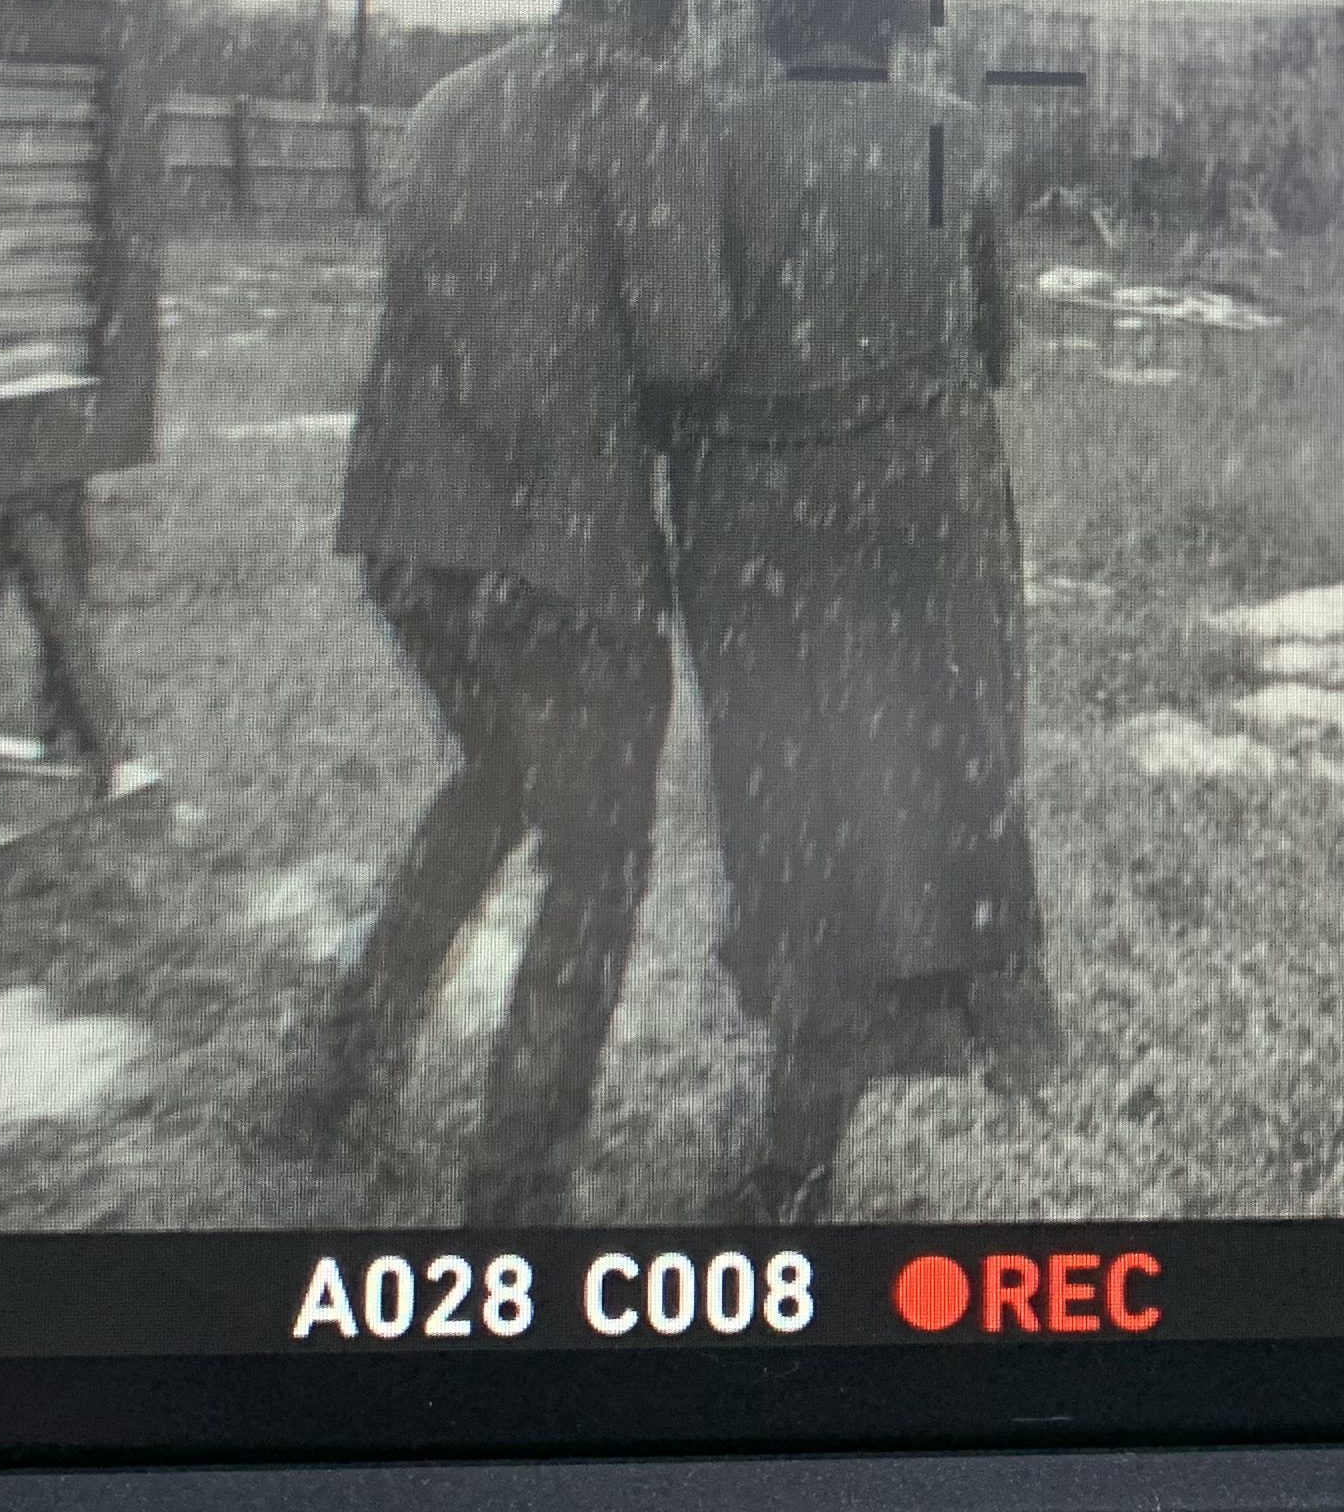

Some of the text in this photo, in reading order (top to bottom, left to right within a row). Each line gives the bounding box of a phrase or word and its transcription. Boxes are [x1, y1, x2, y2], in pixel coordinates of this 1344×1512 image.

[292, 1250, 814, 1338] A028 C008
[983, 1252, 1160, 1333] REC
